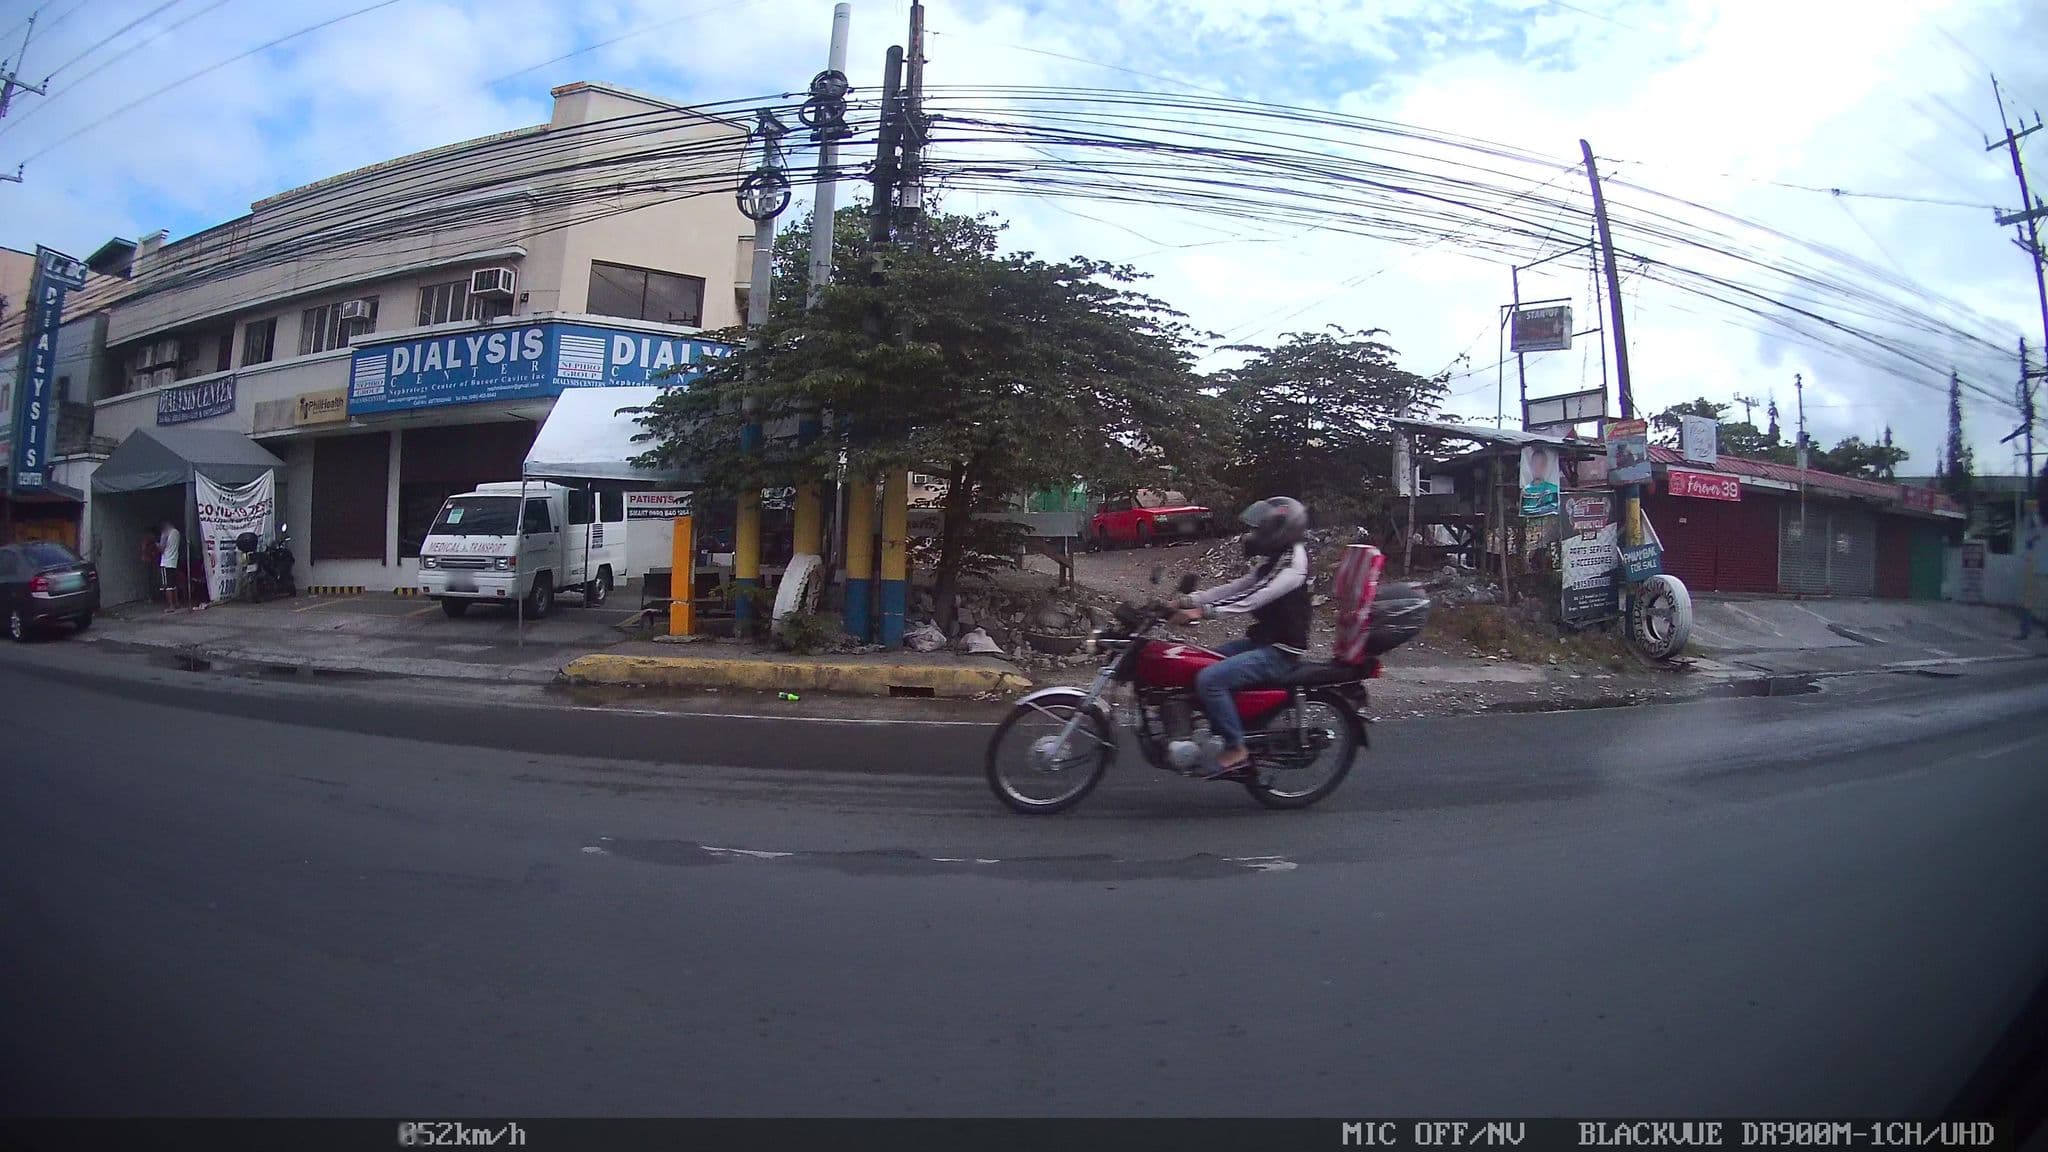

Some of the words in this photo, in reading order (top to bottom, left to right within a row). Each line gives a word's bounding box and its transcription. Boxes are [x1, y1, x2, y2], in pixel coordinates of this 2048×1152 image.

[391, 329, 544, 377] DIALYSIS
[561, 361, 601, 371] NEPHRO
[391, 361, 539, 388] CENTER
[562, 370, 598, 379] GROUP
[308, 397, 344, 413] PhilHealth
[1687, 475, 1720, 496] Forever
[1721, 481, 1738, 497] 39
[629, 495, 675, 504] PATIENTS
[198, 503, 248, 518] COVID-19
[430, 542, 461, 553] MEDICAL
[471, 542, 507, 553] TRANSPORT
